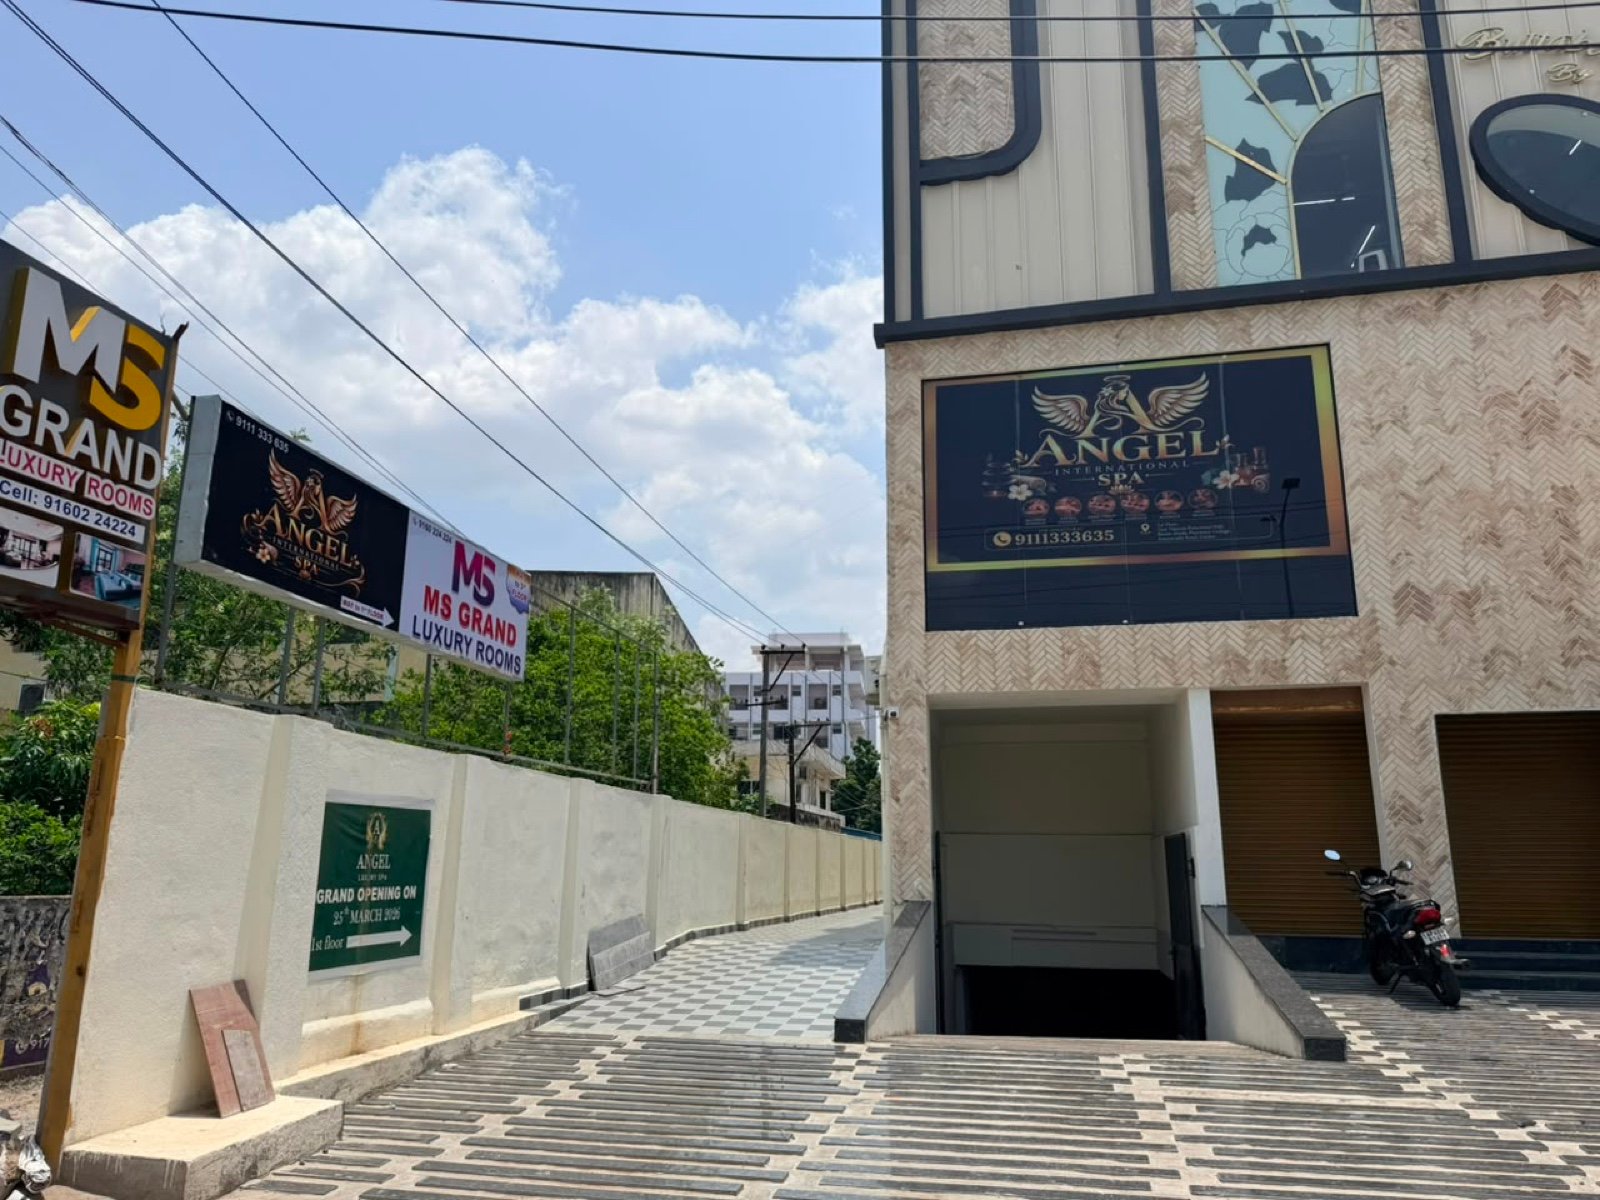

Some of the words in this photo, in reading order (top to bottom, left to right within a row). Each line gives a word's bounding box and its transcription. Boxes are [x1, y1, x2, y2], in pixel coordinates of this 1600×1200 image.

[12, 266, 165, 431] MS
[0, 384, 162, 490] GRAND
[235, 415, 255, 435] 9111
[1023, 429, 1220, 467] ANGEL
[1054, 459, 1190, 476] INTERNATIONAL
[1098, 471, 1144, 487] SPA
[0, 480, 38, 505] Cell:
[43, 495, 90, 522] 91602
[94, 513, 136, 537] 24224
[88, 475, 155, 517] ROOMS
[254, 503, 352, 567] ANGEL
[1015, 529, 1115, 546] 9111333635
[272, 536, 340, 571] INTERNATIONAL
[295, 556, 320, 576] SPA
[450, 540, 496, 607] MS
[423, 584, 452, 621] MS
[458, 601, 517, 649] GRAND
[412, 614, 473, 657] LUXURY
[475, 640, 521, 675] ROOMS
[356, 854, 391, 870] ANGEL
[316, 886, 355, 904] GRAND
[357, 885, 400, 902] OPENING
[403, 884, 417, 900] ON
[349, 908, 382, 924] MARCH
[324, 934, 344, 950] floor
